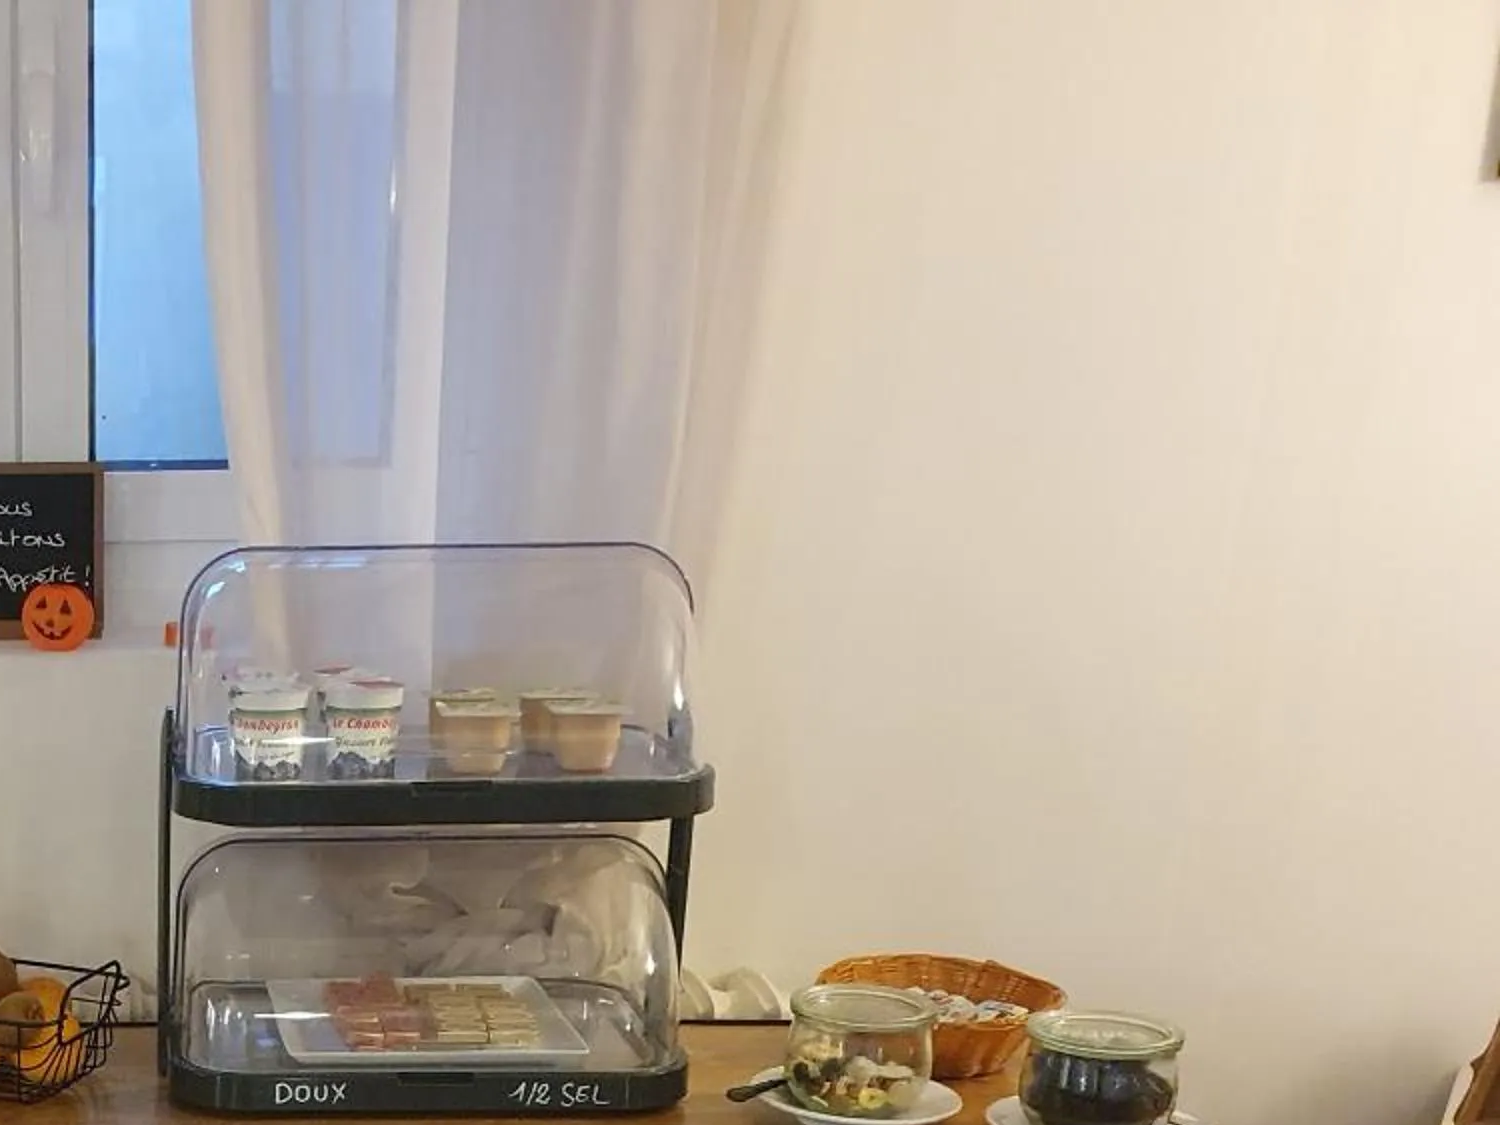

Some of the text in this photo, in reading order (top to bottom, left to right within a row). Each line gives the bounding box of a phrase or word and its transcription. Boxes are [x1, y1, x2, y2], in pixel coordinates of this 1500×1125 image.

[274, 1082, 348, 1104] DOUX
[508, 1082, 610, 1106] 1/2 SEL
